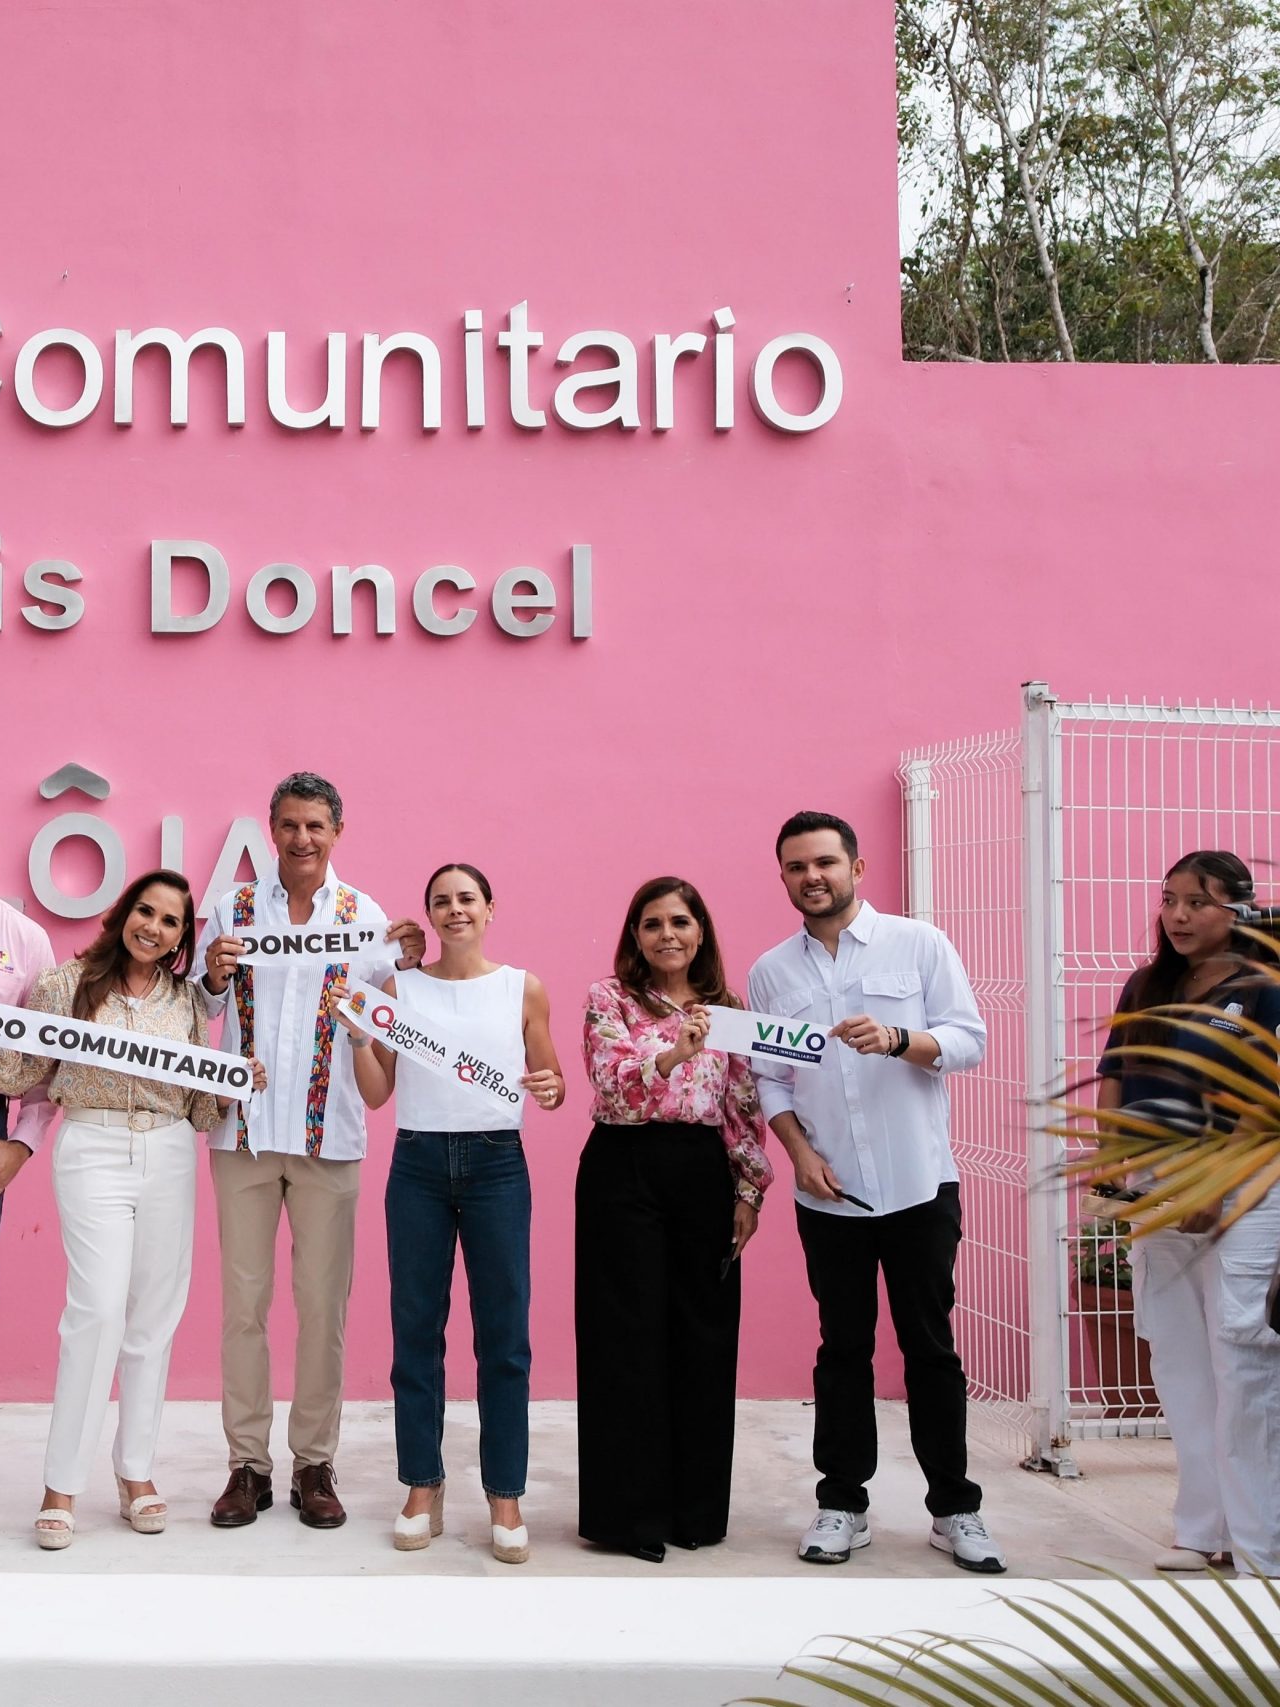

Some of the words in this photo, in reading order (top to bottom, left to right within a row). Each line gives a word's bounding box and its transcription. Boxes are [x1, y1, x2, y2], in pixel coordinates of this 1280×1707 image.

[150, 539, 593, 639] Doncel
[371, 1005, 446, 1058] QUINTANA
[386, 1030, 414, 1049] ROO
[756, 1021, 826, 1052] VIVO
[38, 1024, 249, 1088] COMUNITARIO
[759, 1045, 778, 1053] GRUPO
[458, 1050, 504, 1082] NUEVO
